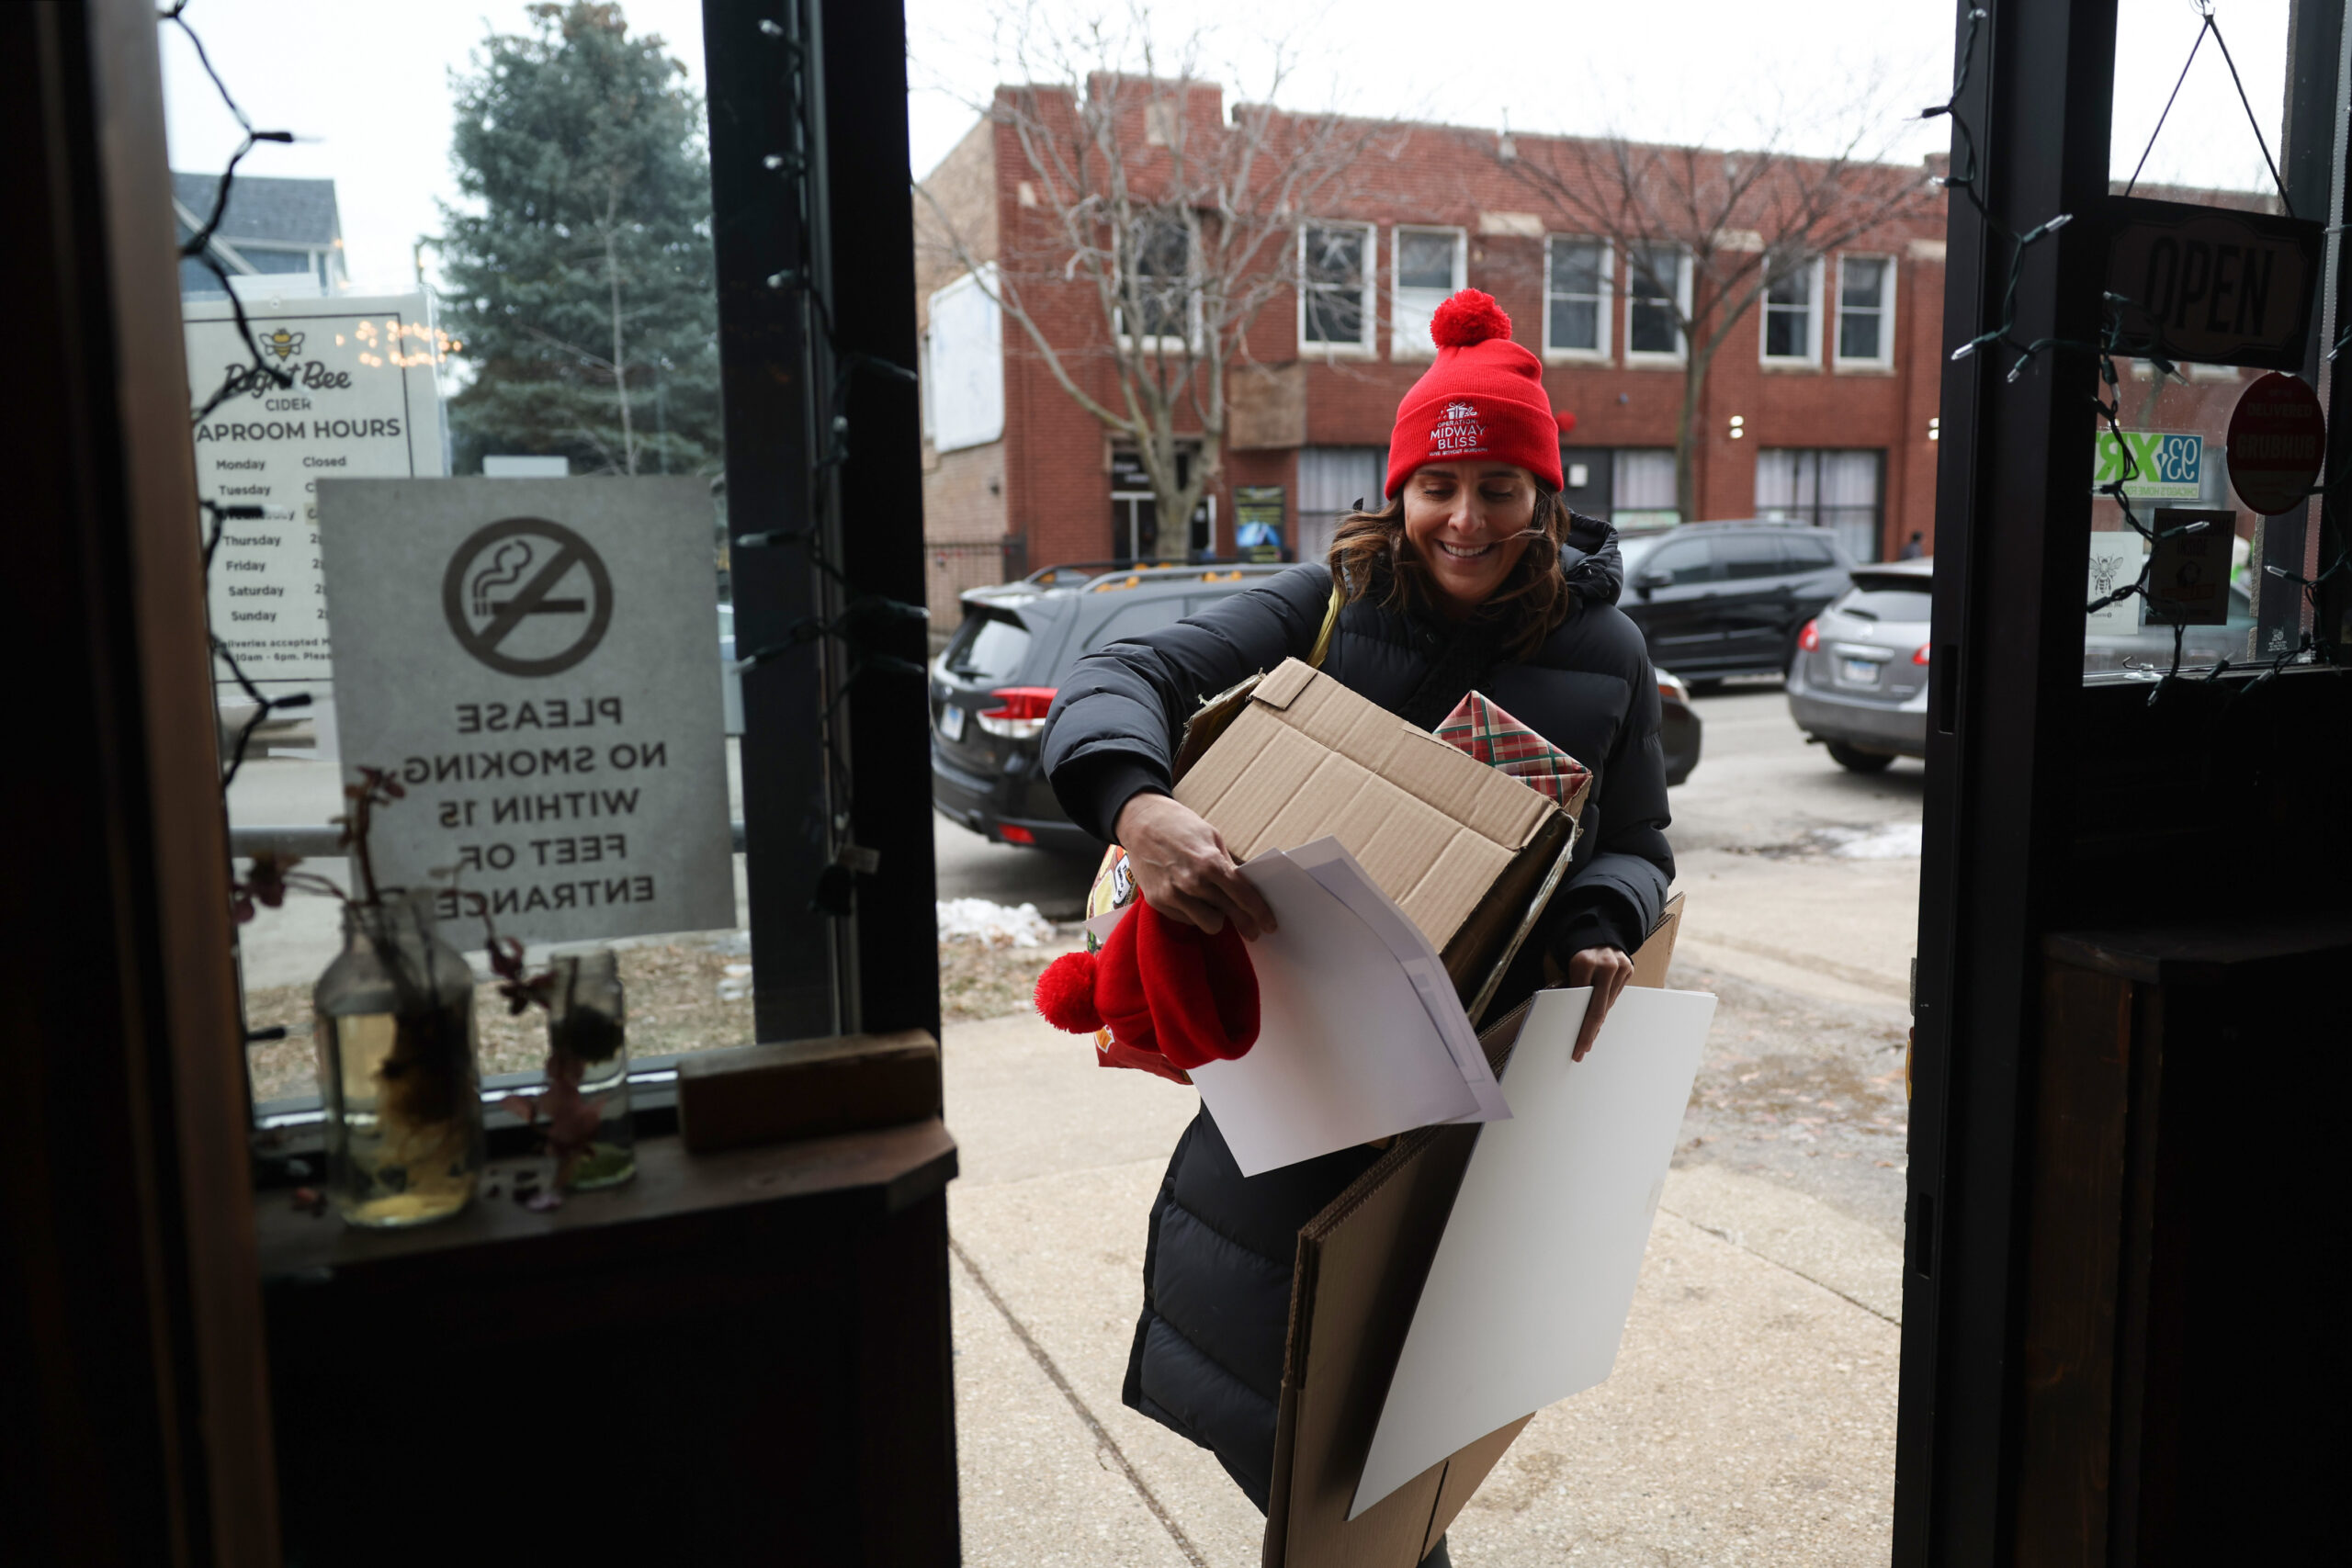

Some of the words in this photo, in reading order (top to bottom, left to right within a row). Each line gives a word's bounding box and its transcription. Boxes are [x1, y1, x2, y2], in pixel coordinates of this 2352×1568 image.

[2144, 235, 2276, 336] OPEN
[302, 361, 352, 389] Bee
[265, 398, 311, 412] CIDER
[2246, 402, 2313, 418] DELIVERED
[197, 422, 305, 442] APROOM
[314, 418, 401, 438] HOURS
[1430, 424, 1487, 441] MIDWAY
[1438, 435, 1477, 450] BLISS
[2236, 434, 2317, 461] GRUBHUB
[216, 459, 266, 471] Monday
[302, 456, 346, 468] Closed
[219, 484, 271, 496] Tuesday
[223, 535, 281, 547] Thursday
[226, 559, 266, 572] Friday
[228, 584, 284, 597] Saturday
[231, 610, 277, 623] Sunday
[270, 639, 318, 649] accepted
